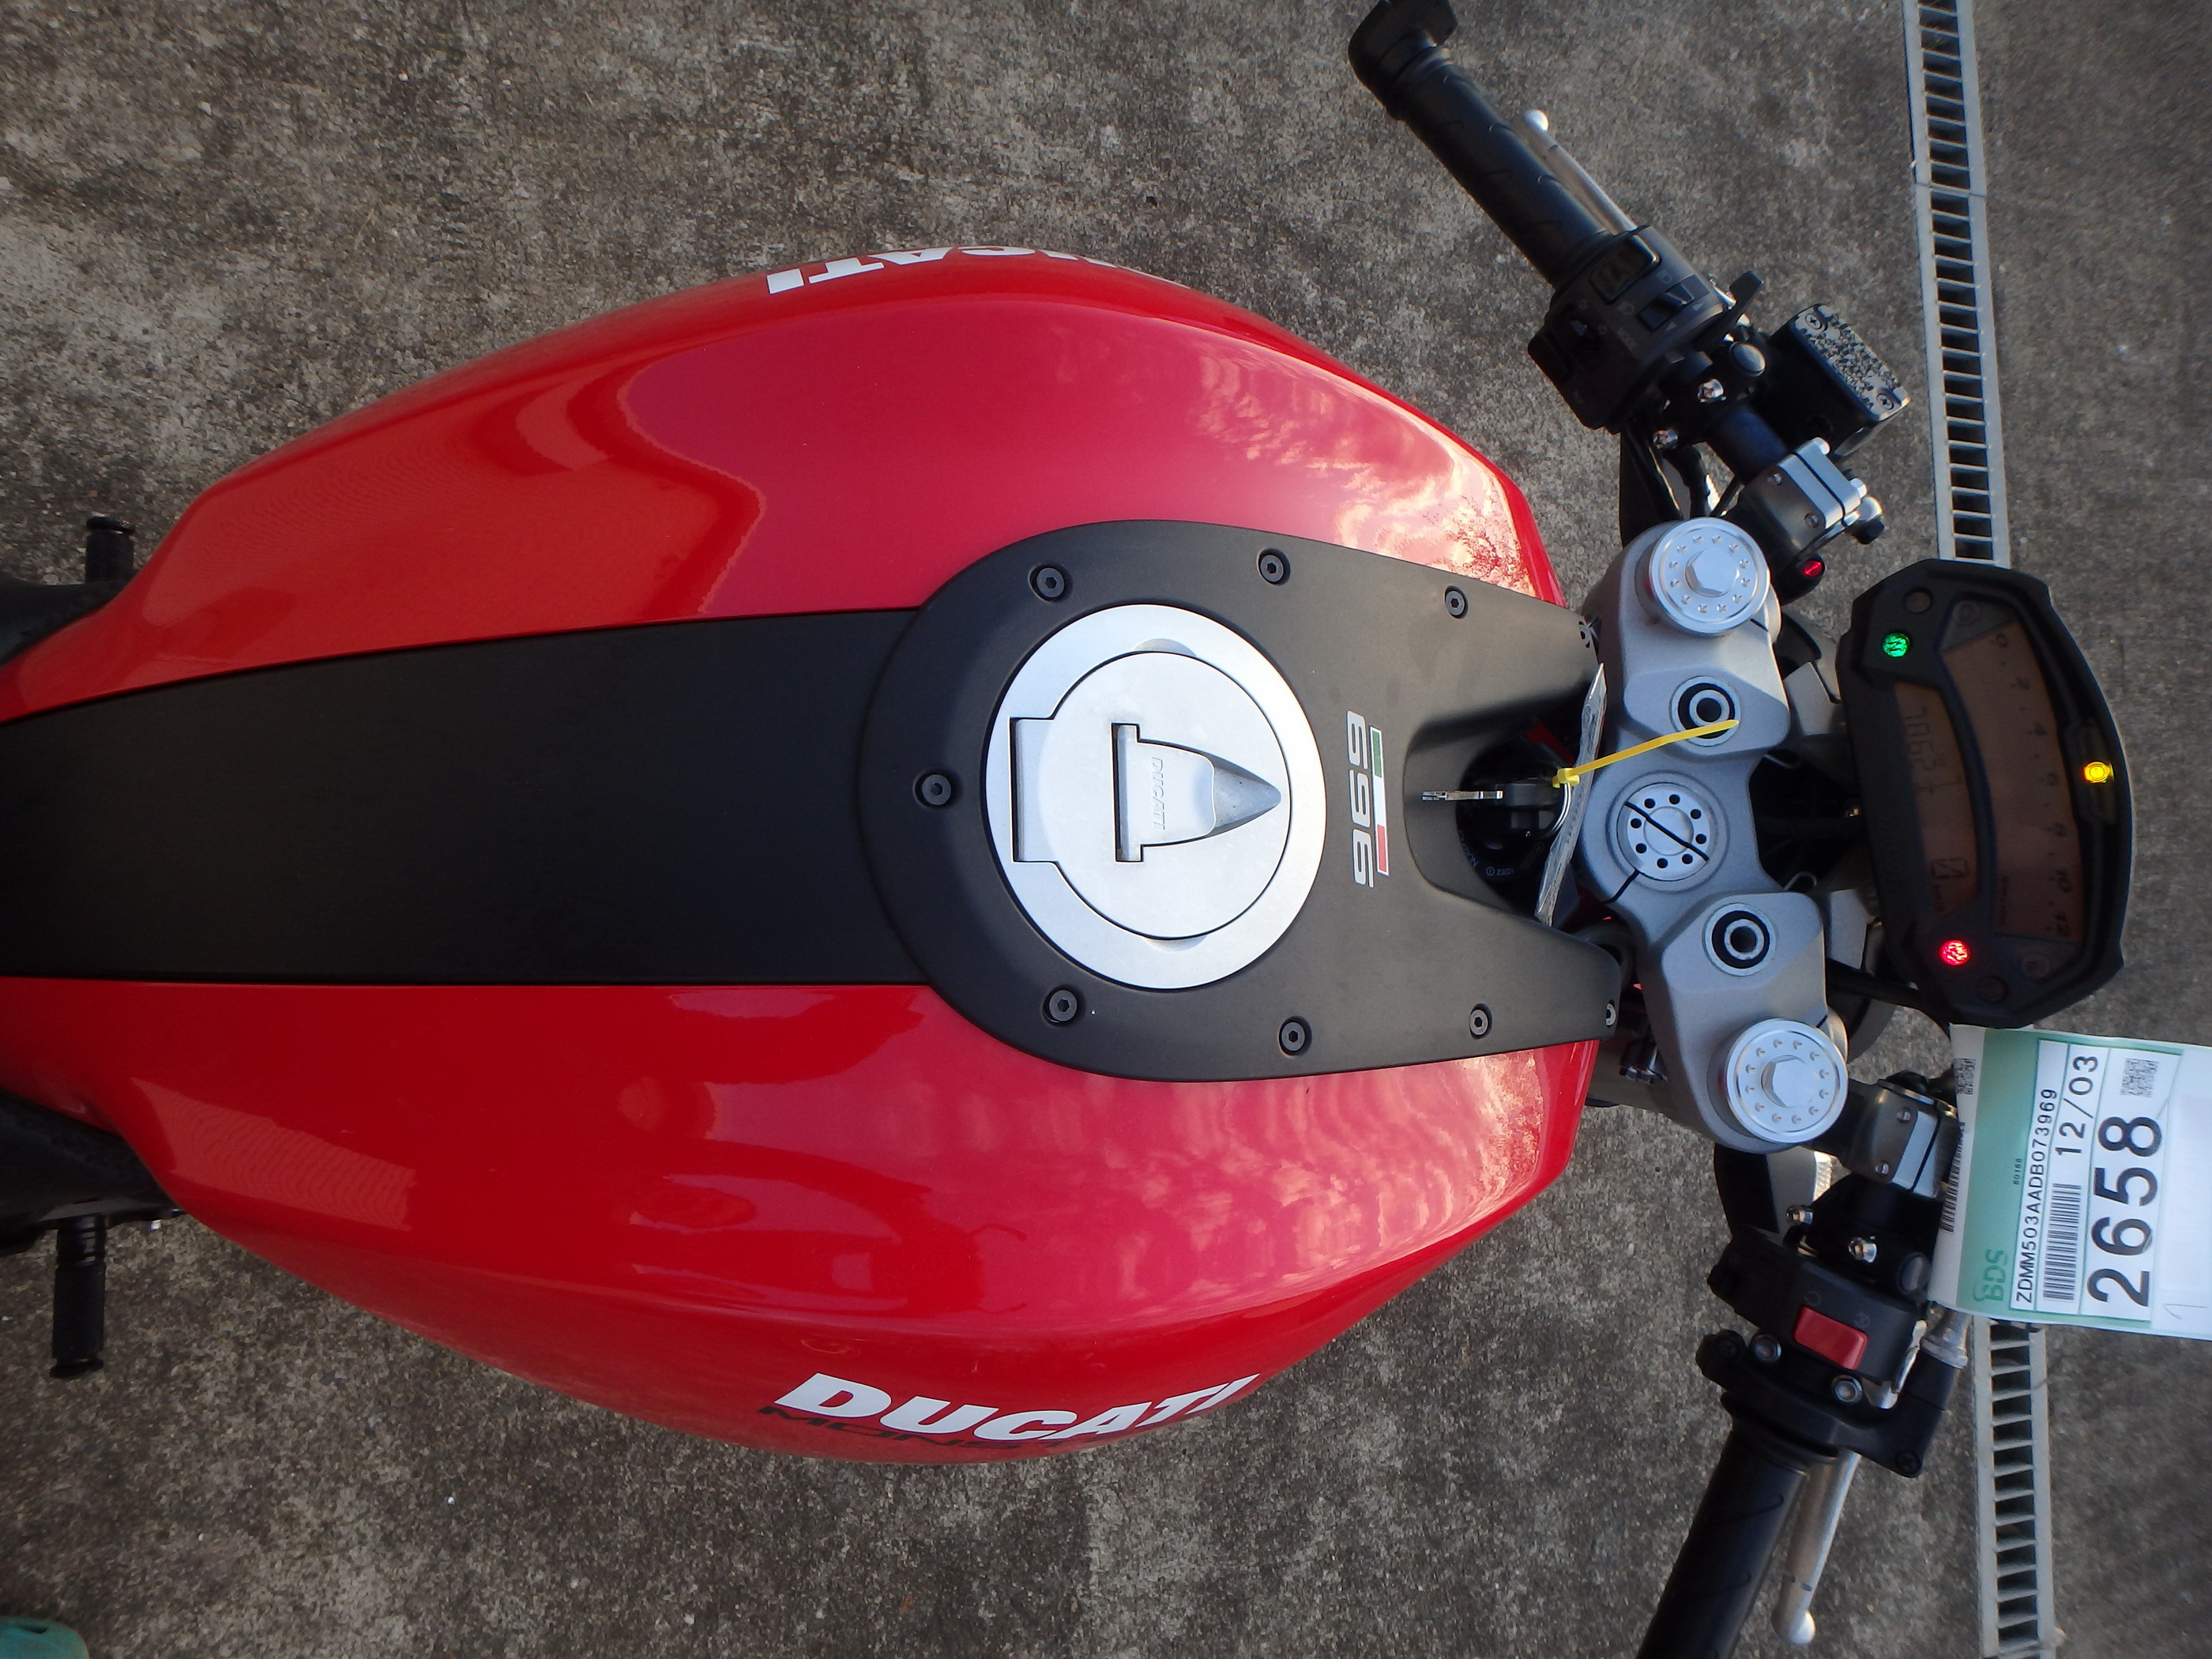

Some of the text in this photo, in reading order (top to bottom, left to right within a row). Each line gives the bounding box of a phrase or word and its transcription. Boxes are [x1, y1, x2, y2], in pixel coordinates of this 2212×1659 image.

[2015, 676, 2030, 690] 2
[2033, 722, 2047, 736] 4
[2046, 772, 2060, 787] 6
[1150, 756, 1166, 830] DUCATI
[2055, 822, 2069, 837] 8
[1496, 867, 1514, 876] ZADI
[2057, 868, 2072, 893] 10
[2055, 912, 2070, 937] 12
[2055, 1055, 2099, 1156] 12/03
[2015, 1088, 2058, 1304] ZDMM503AADB073969
[2086, 1115, 2163, 1307] 2658
[1973, 1249, 2008, 1302] BDS
[774, 1372, 1261, 1442] DUCATI
